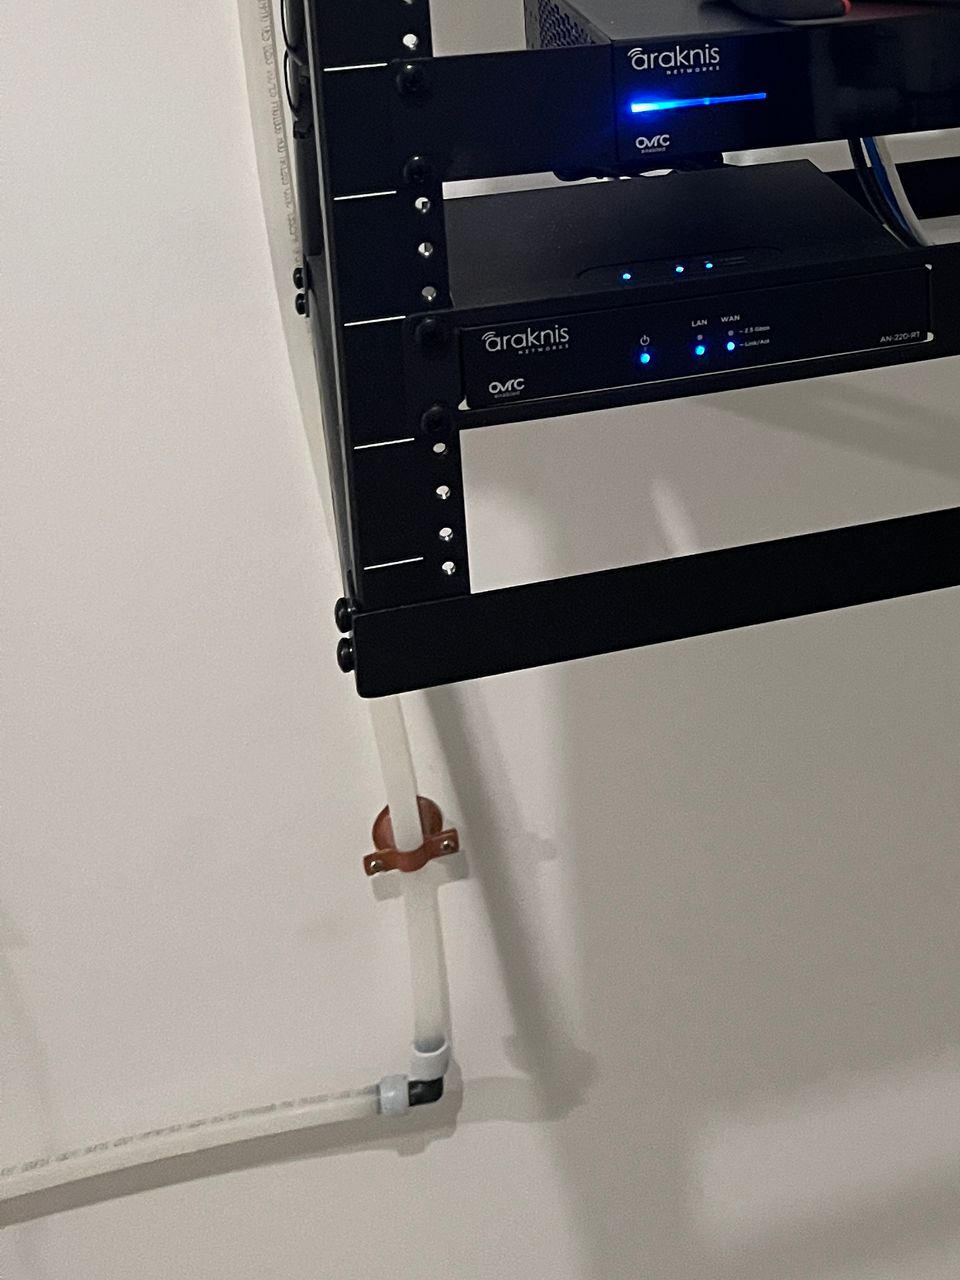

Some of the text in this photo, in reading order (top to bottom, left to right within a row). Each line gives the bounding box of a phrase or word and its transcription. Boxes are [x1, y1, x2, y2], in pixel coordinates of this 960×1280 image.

[629, 43, 720, 70] araknis
[691, 319, 708, 327] LAN
[720, 314, 740, 323] WAN
[482, 324, 569, 352] araknis
